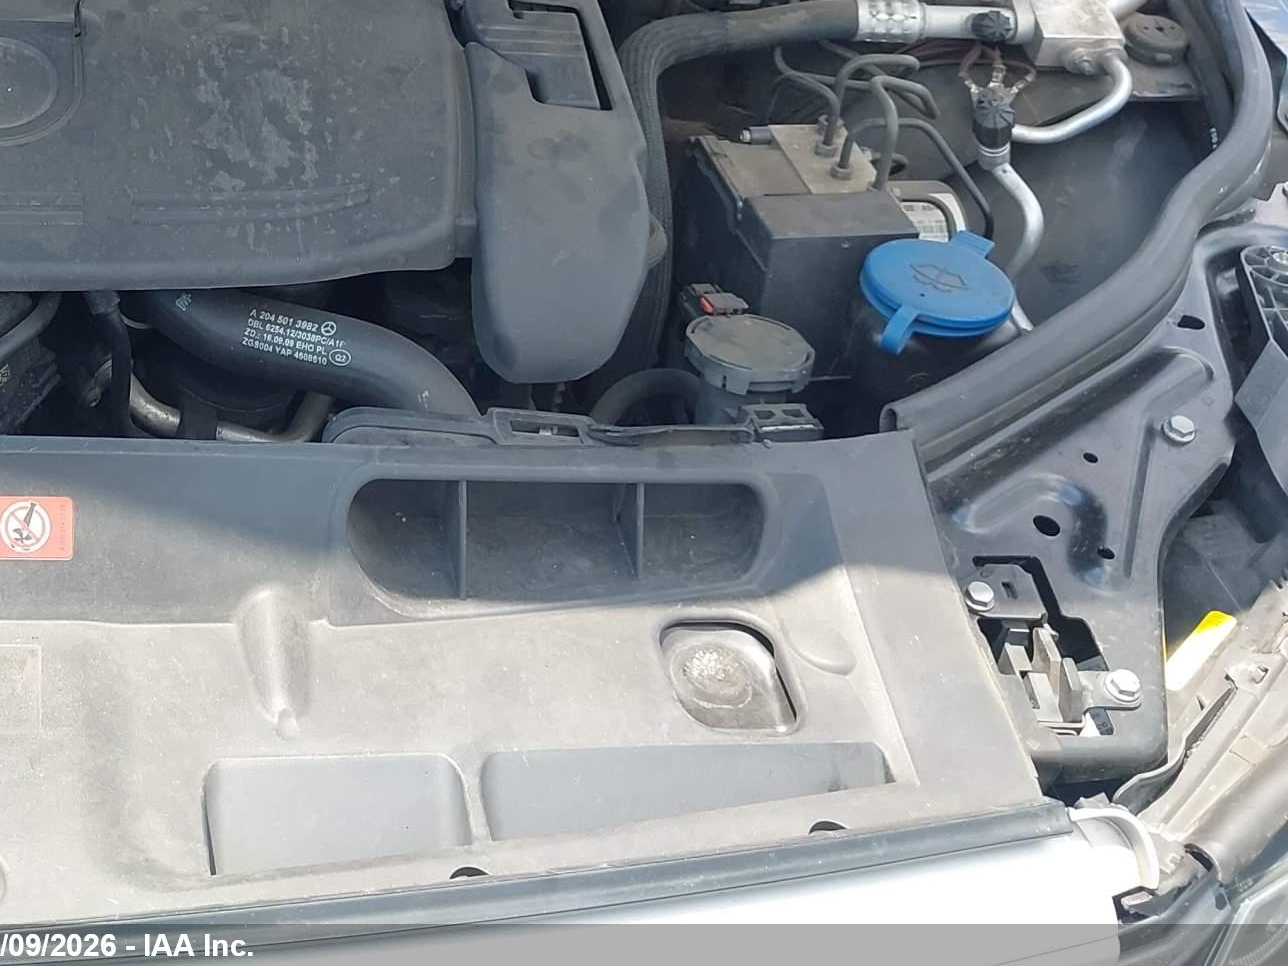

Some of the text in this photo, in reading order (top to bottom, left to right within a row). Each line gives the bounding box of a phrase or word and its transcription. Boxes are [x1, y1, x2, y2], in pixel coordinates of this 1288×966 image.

[247, 318, 264, 330] DBL
[250, 309, 319, 332] A 204 501 3982
[275, 346, 292, 357] YAP
[316, 346, 328, 355] PL
